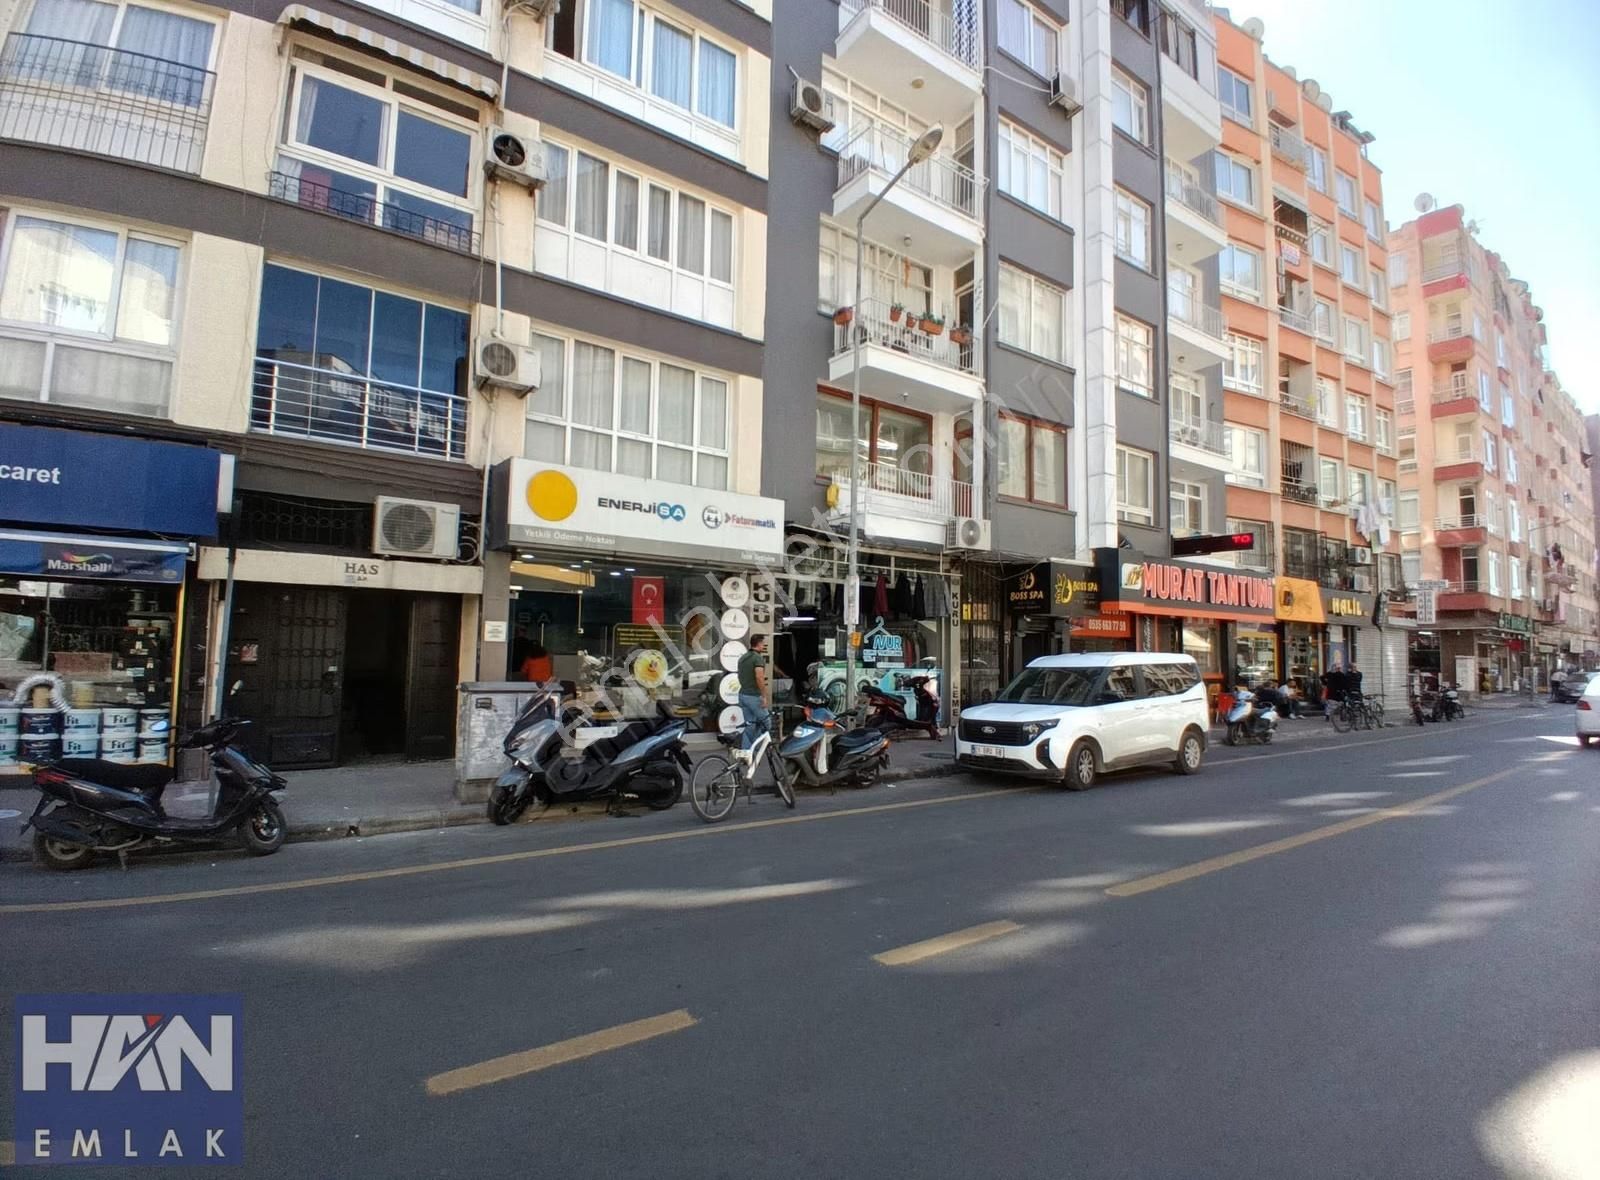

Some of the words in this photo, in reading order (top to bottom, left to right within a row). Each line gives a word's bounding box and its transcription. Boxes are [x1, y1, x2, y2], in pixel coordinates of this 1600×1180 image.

[597, 496, 687, 522] ENERJİSA
[553, 530, 584, 544] Ödeme
[48, 559, 107, 573] Marshall
[344, 562, 379, 575] HAS
[1142, 562, 1203, 602] MURAT
[1207, 570, 1274, 610] TANTUNİ
[753, 582, 771, 624] KURU
[1009, 591, 1028, 601] BOSS
[1028, 590, 1044, 600] SPA
[951, 592, 960, 627] KURU
[873, 634, 902, 650] NUR
